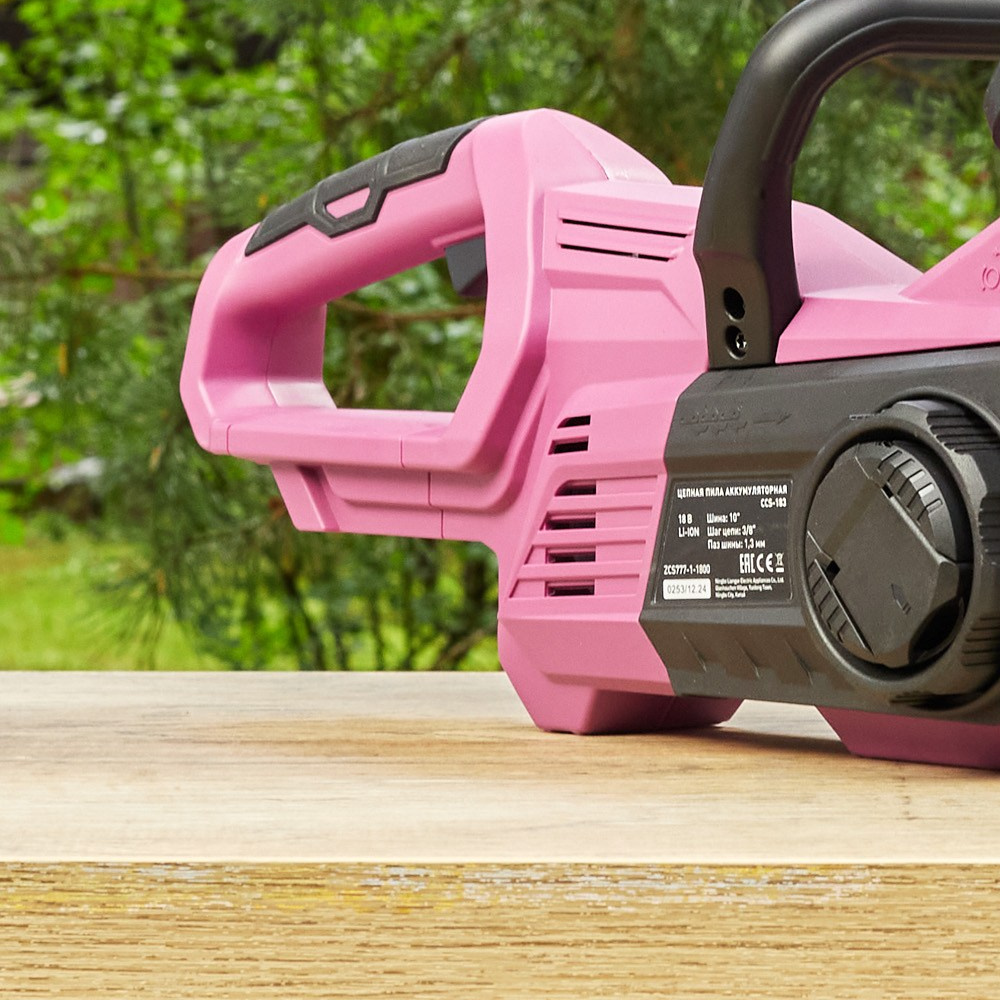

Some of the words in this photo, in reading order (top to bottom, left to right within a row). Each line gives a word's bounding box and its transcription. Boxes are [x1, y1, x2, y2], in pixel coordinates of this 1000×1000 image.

[677, 487, 704, 499] ЦЕПНАЯ
[705, 486, 724, 497] ПИЛА
[725, 484, 788, 497] АККУМУЛЯТОРНАЯ
[760, 497, 787, 508] CCS-183
[678, 513, 686, 524] 18
[706, 512, 728, 524] Шина:
[678, 526, 700, 537] LI-ION
[707, 526, 721, 537] Шаг
[722, 525, 741, 538] цепи:
[707, 538, 720, 549] Паз
[721, 539, 743, 550] шины:
[744, 538, 754, 550] 1,3
[755, 539, 766, 549] мм
